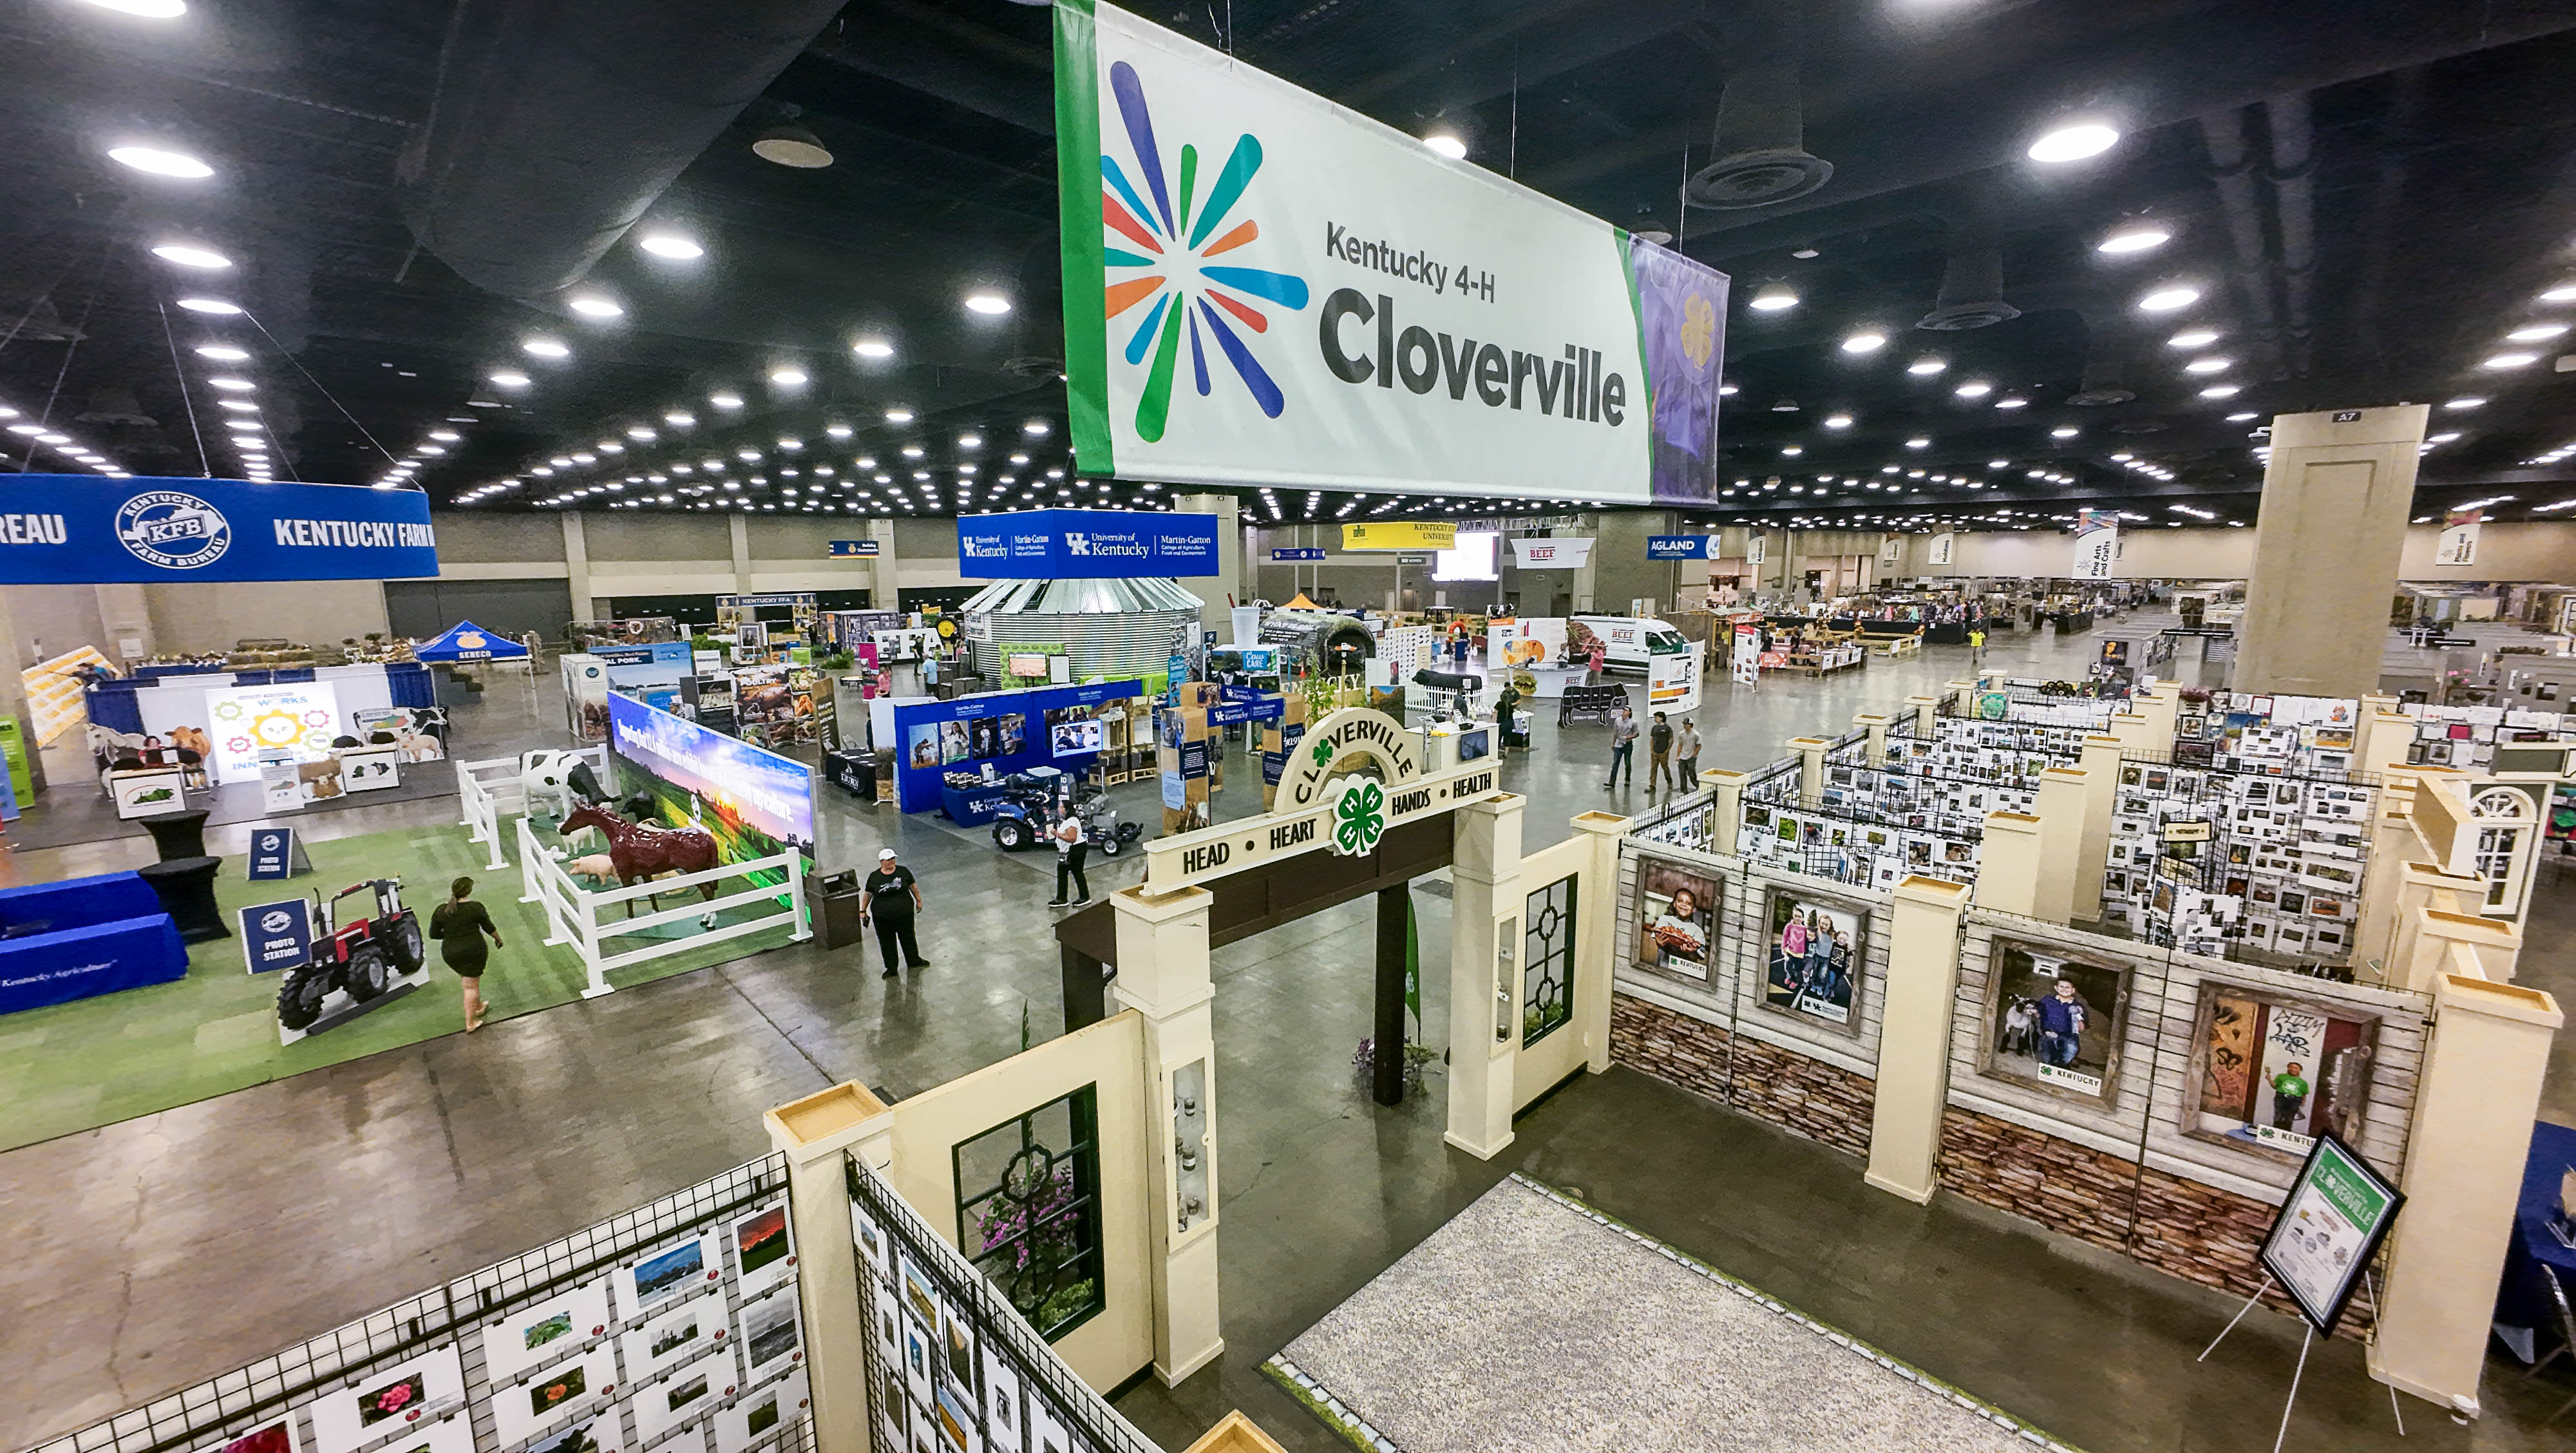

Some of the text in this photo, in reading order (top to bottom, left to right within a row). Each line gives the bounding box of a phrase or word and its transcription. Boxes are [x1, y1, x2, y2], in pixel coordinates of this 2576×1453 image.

[1327, 221, 1495, 303] Kentucky 4-H
[1320, 288, 1625, 426] Cloverville
[2338, 413, 2356, 422] A7
[124, 493, 205, 517] KENTUCKY
[149, 518, 203, 544] KFB
[274, 519, 394, 547] KENTUCKY
[1091, 533, 1135, 543] University of
[1161, 535, 1211, 544] Martin-Gatton
[1651, 540, 1695, 551] AGLAND
[130, 537, 226, 566] FARM BUREAU
[976, 543, 1008, 560] Kentucky
[1092, 542, 1149, 559] Kentucky
[1530, 549, 1555, 558] BEEF
[2101, 541, 2110, 562] Crafts
[2091, 561, 2100, 576] Fine
[1612, 631, 1634, 639] BEEF
[1246, 660, 1264, 668] CARE
[739, 678, 777, 686] POULTRY
[1225, 711, 1249, 721] Kentucky
[1453, 773, 1492, 799] HEALTH
[1392, 788, 1431, 815] HANDS
[1270, 819, 1316, 850] HEART
[1183, 843, 1230, 875] HEAD
[264, 937, 296, 951] PHOTO
[263, 947, 300, 962] STATION
[2, 973, 51, 987] Kentucky
[2057, 1070, 2099, 1087] KENTUCKY
[2281, 1132, 2314, 1147] KENTU
